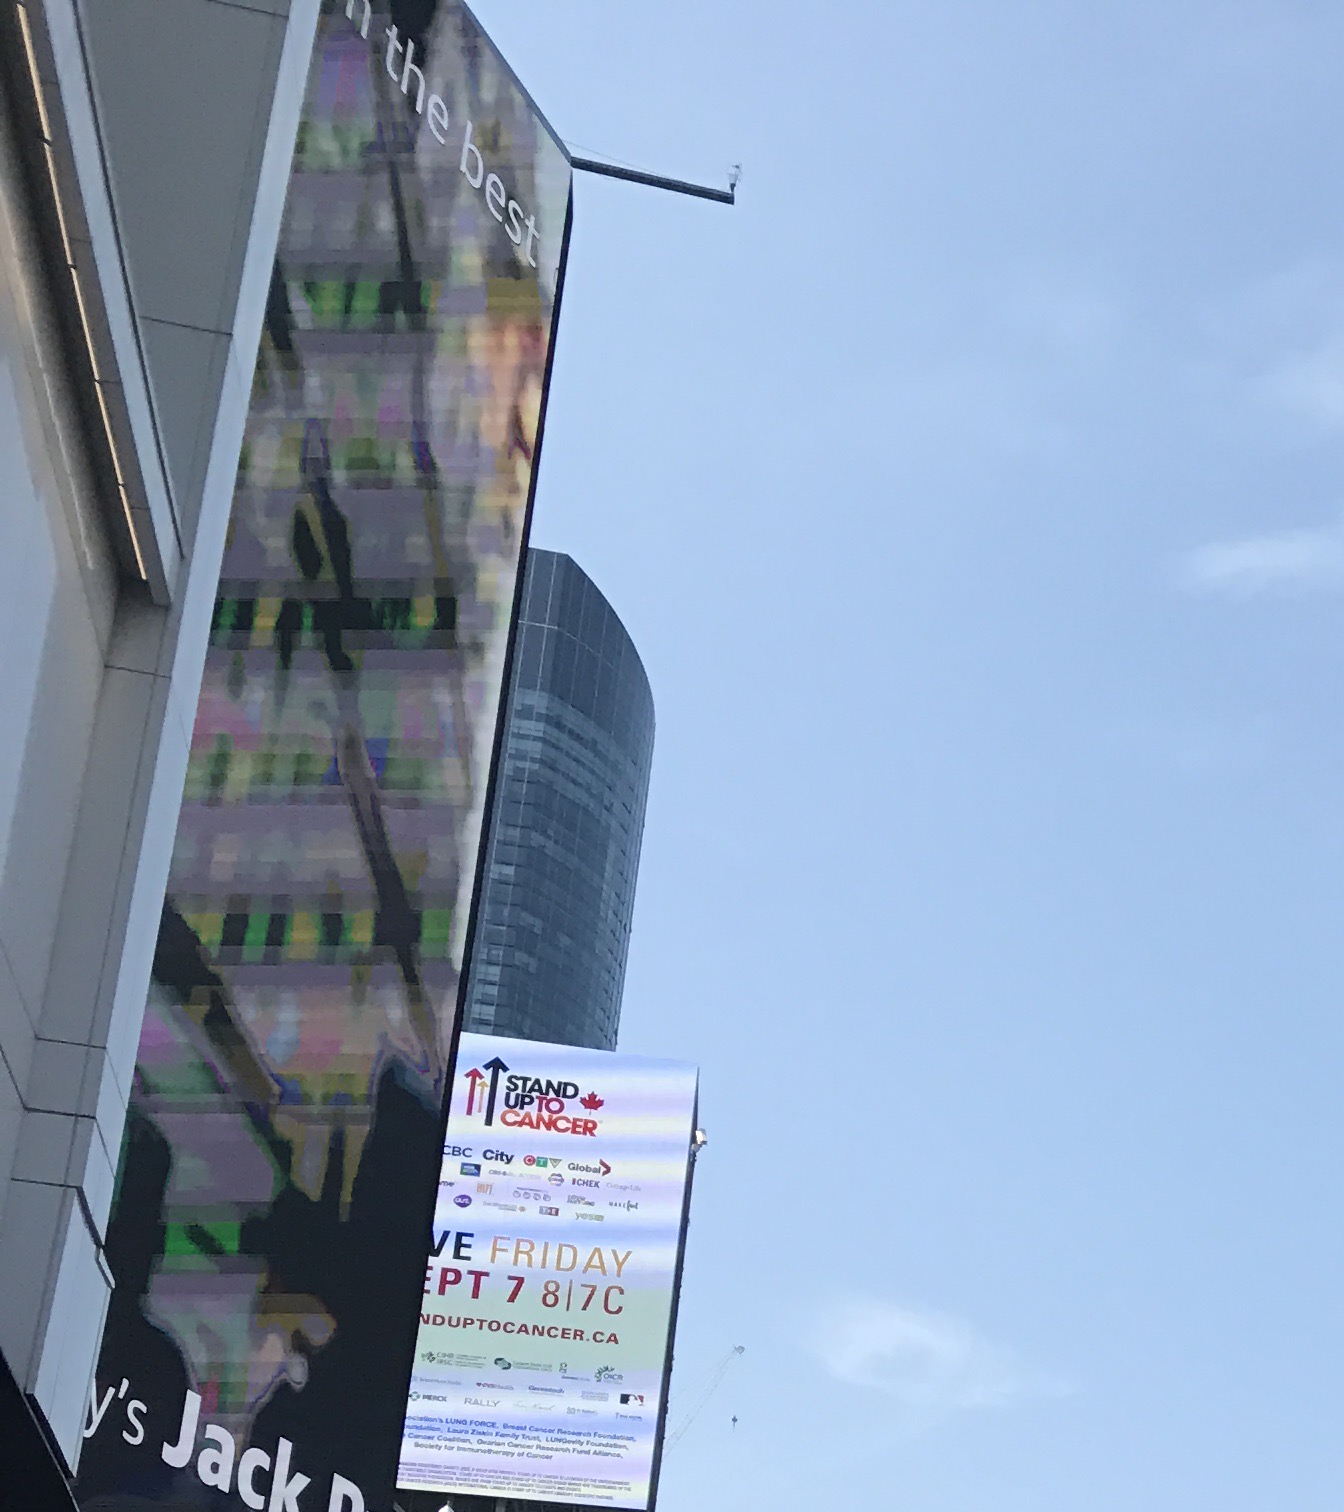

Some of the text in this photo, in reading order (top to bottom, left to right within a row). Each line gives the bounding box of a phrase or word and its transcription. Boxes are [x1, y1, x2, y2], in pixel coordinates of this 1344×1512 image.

[384, 24, 541, 267] the best
[504, 1073, 579, 1100] STAND
[500, 1109, 599, 1137] CANCER
[482, 1149, 601, 1175] City Global
[489, 1235, 633, 1278] FRIDAY
[423, 1265, 625, 1315] EPT 7 8|7C
[419, 1312, 620, 1345] NDUPTOCANCER.CA
[82, 1377, 148, 1446] y's
